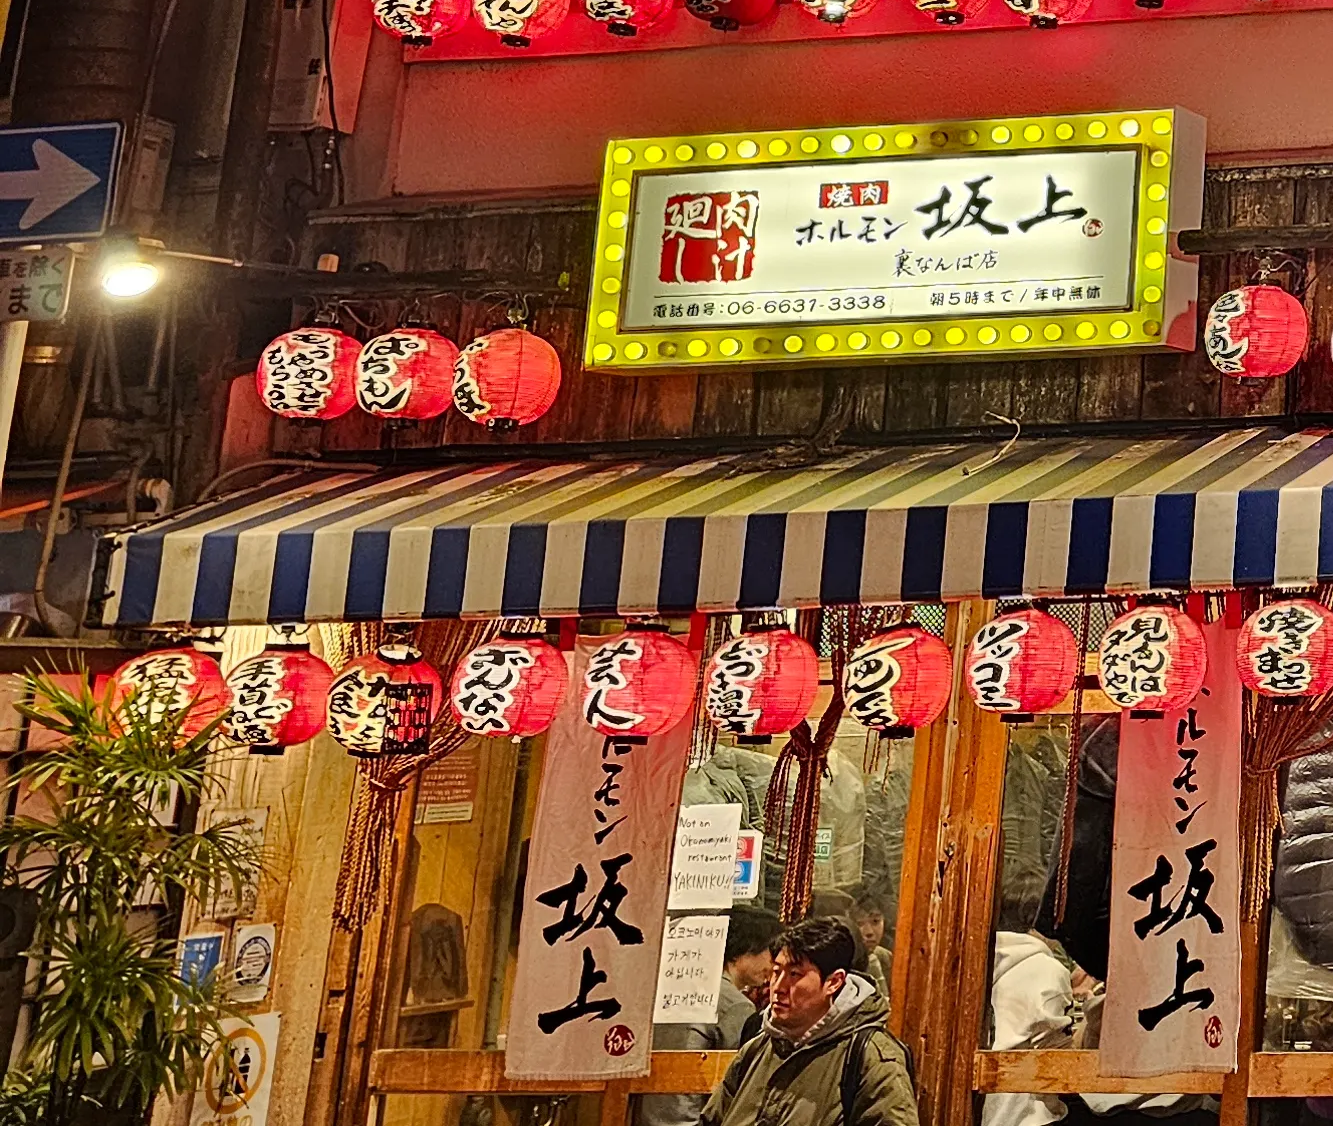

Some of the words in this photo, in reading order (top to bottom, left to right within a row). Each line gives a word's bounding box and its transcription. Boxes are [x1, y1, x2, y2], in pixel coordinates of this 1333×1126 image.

[795, 216, 908, 247] ホルモン
[913, 177, 1088, 237] 坂上
[826, 183, 885, 207] 焼肉
[711, 189, 759, 283] 肉汁
[893, 248, 999, 277] 裏なんば店
[361, 334, 424, 413] ぱちもん
[582, 641, 644, 727] 芸人
[966, 629, 1025, 713] ツッコミ
[1252, 607, 1324, 693] 焼きまっせ
[679, 816, 697, 829] Not
[680, 834, 733, 848] Okonomiyaki
[687, 853, 732, 863] restaurant
[535, 852, 645, 1035] 坂上
[1126, 838, 1224, 1032] 坂上
